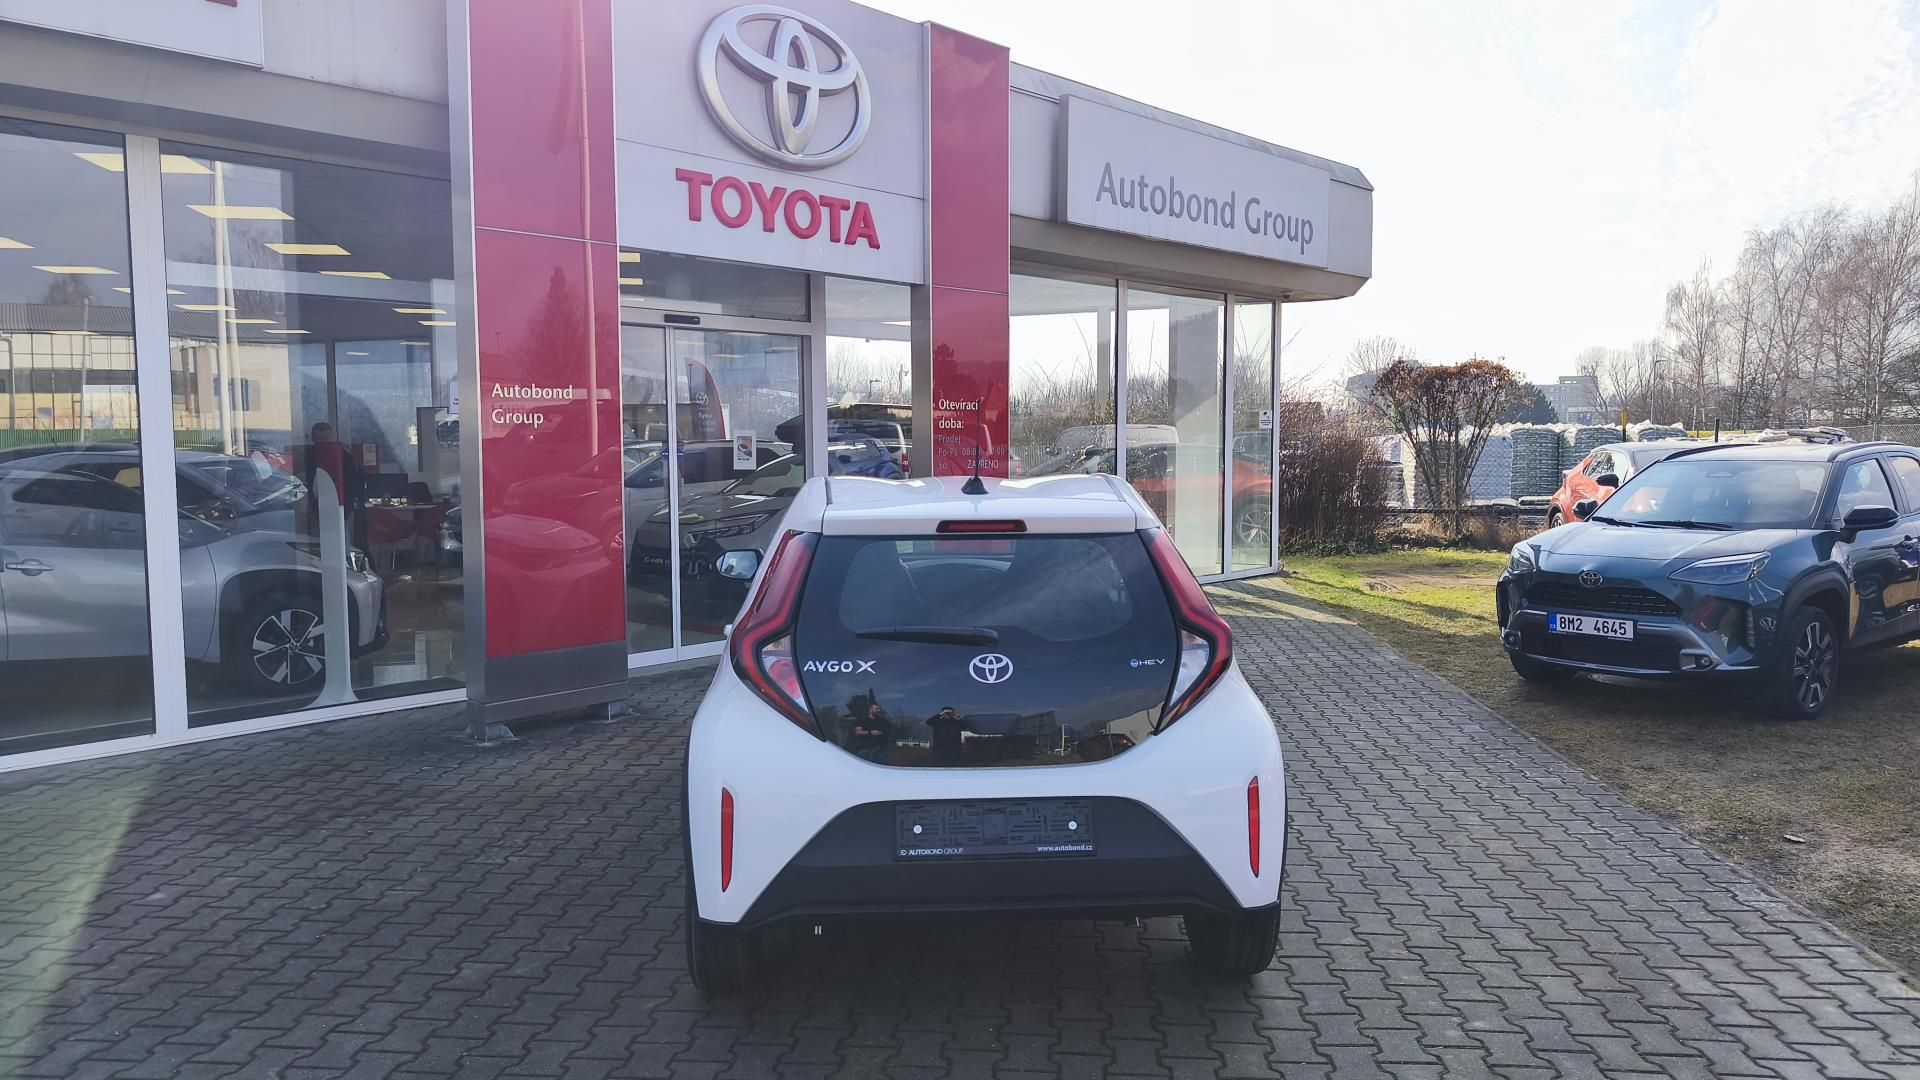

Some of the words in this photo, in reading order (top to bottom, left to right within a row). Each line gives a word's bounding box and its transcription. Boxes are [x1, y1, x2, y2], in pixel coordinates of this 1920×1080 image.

[675, 167, 880, 250] TOYOTA
[1095, 162, 1236, 230] Autobond
[1244, 197, 1314, 255] Group
[491, 383, 573, 400] Autobond
[938, 398, 978, 410] Otevírací
[491, 408, 544, 429] Group
[938, 417, 964, 429] doba:
[938, 434, 961, 445] Prodej
[1559, 616, 1583, 632] 8M2
[1593, 619, 1627, 636] 4645
[803, 660, 854, 673] AYGO
[855, 659, 877, 674] X
[1139, 658, 1165, 666] HEV
[1036, 844, 1093, 852] www.autobond.cz
